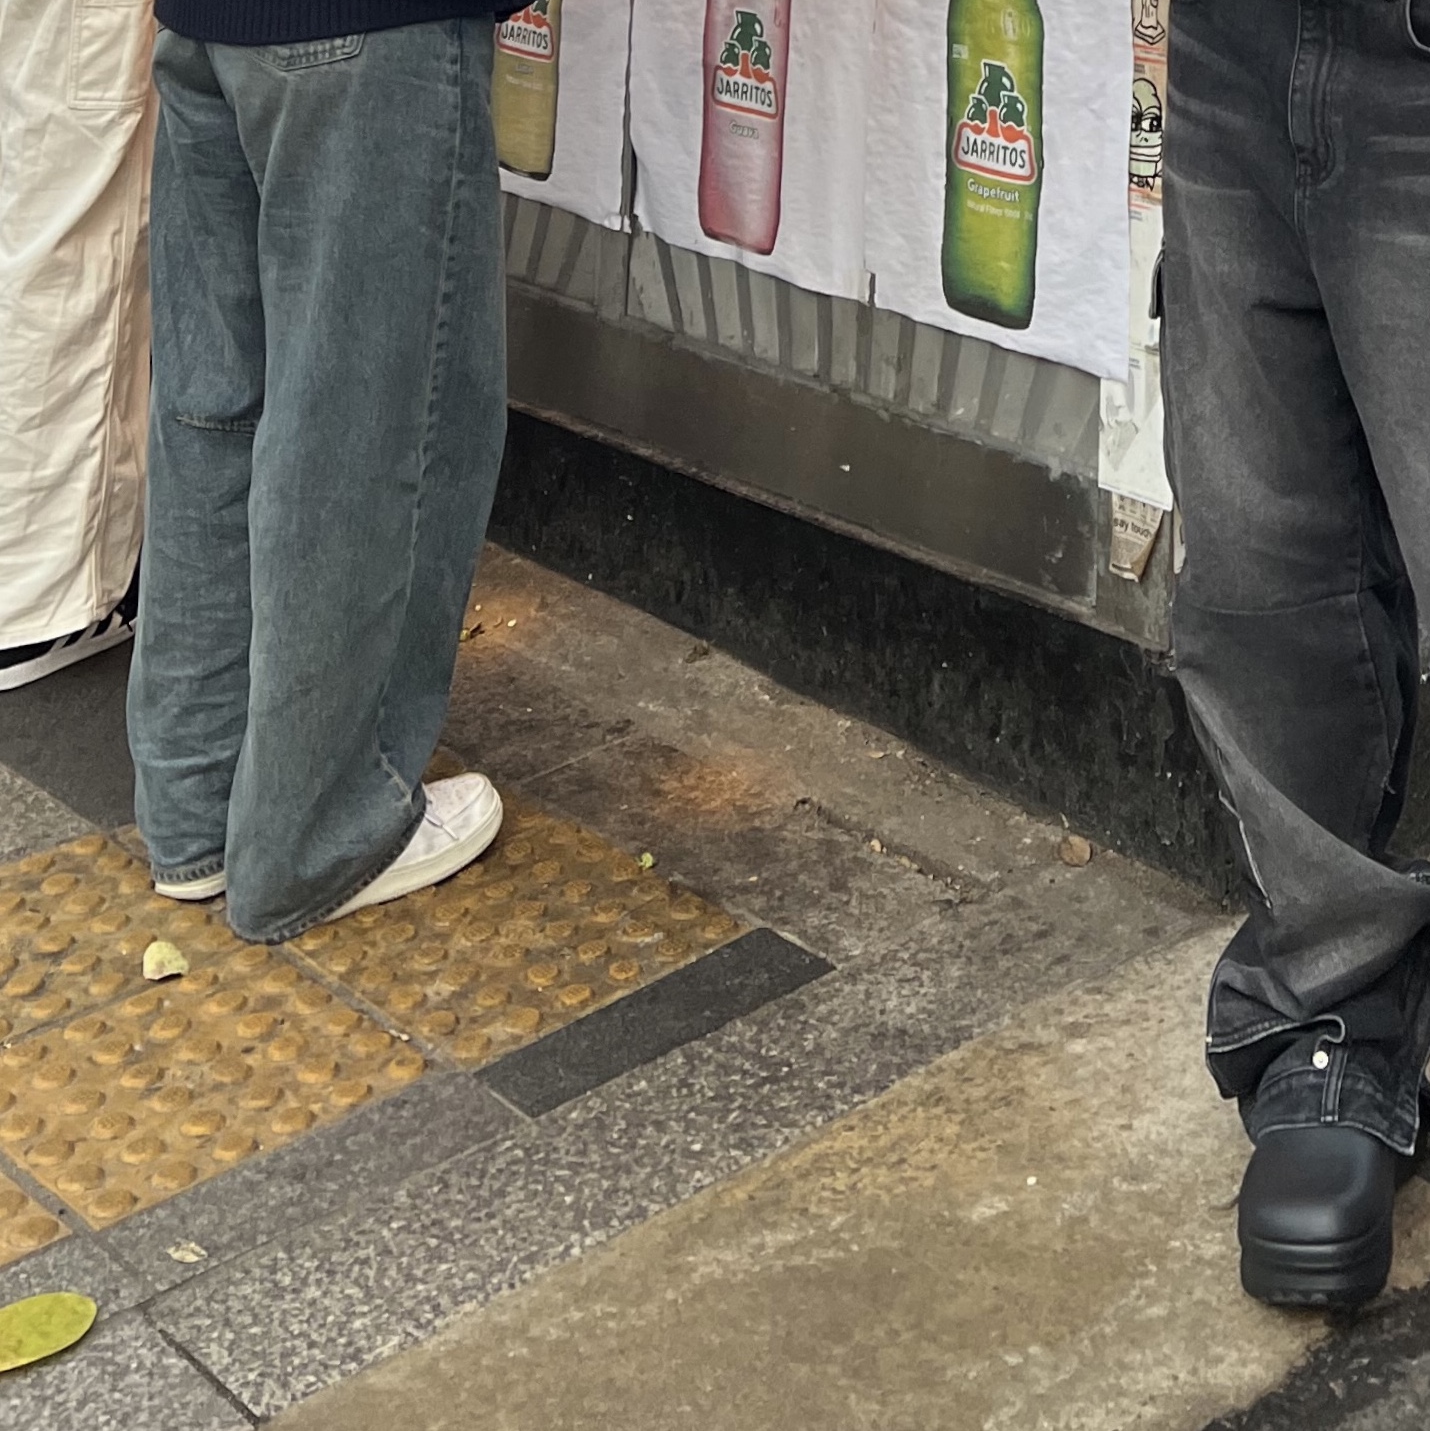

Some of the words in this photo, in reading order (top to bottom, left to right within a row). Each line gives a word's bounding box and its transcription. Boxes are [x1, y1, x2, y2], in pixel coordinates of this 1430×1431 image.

[501, 20, 549, 51] JARRITOS
[716, 77, 773, 108] JARRITOS
[961, 135, 1027, 170] JARRITOS
[967, 177, 1021, 203] Grapefruit
